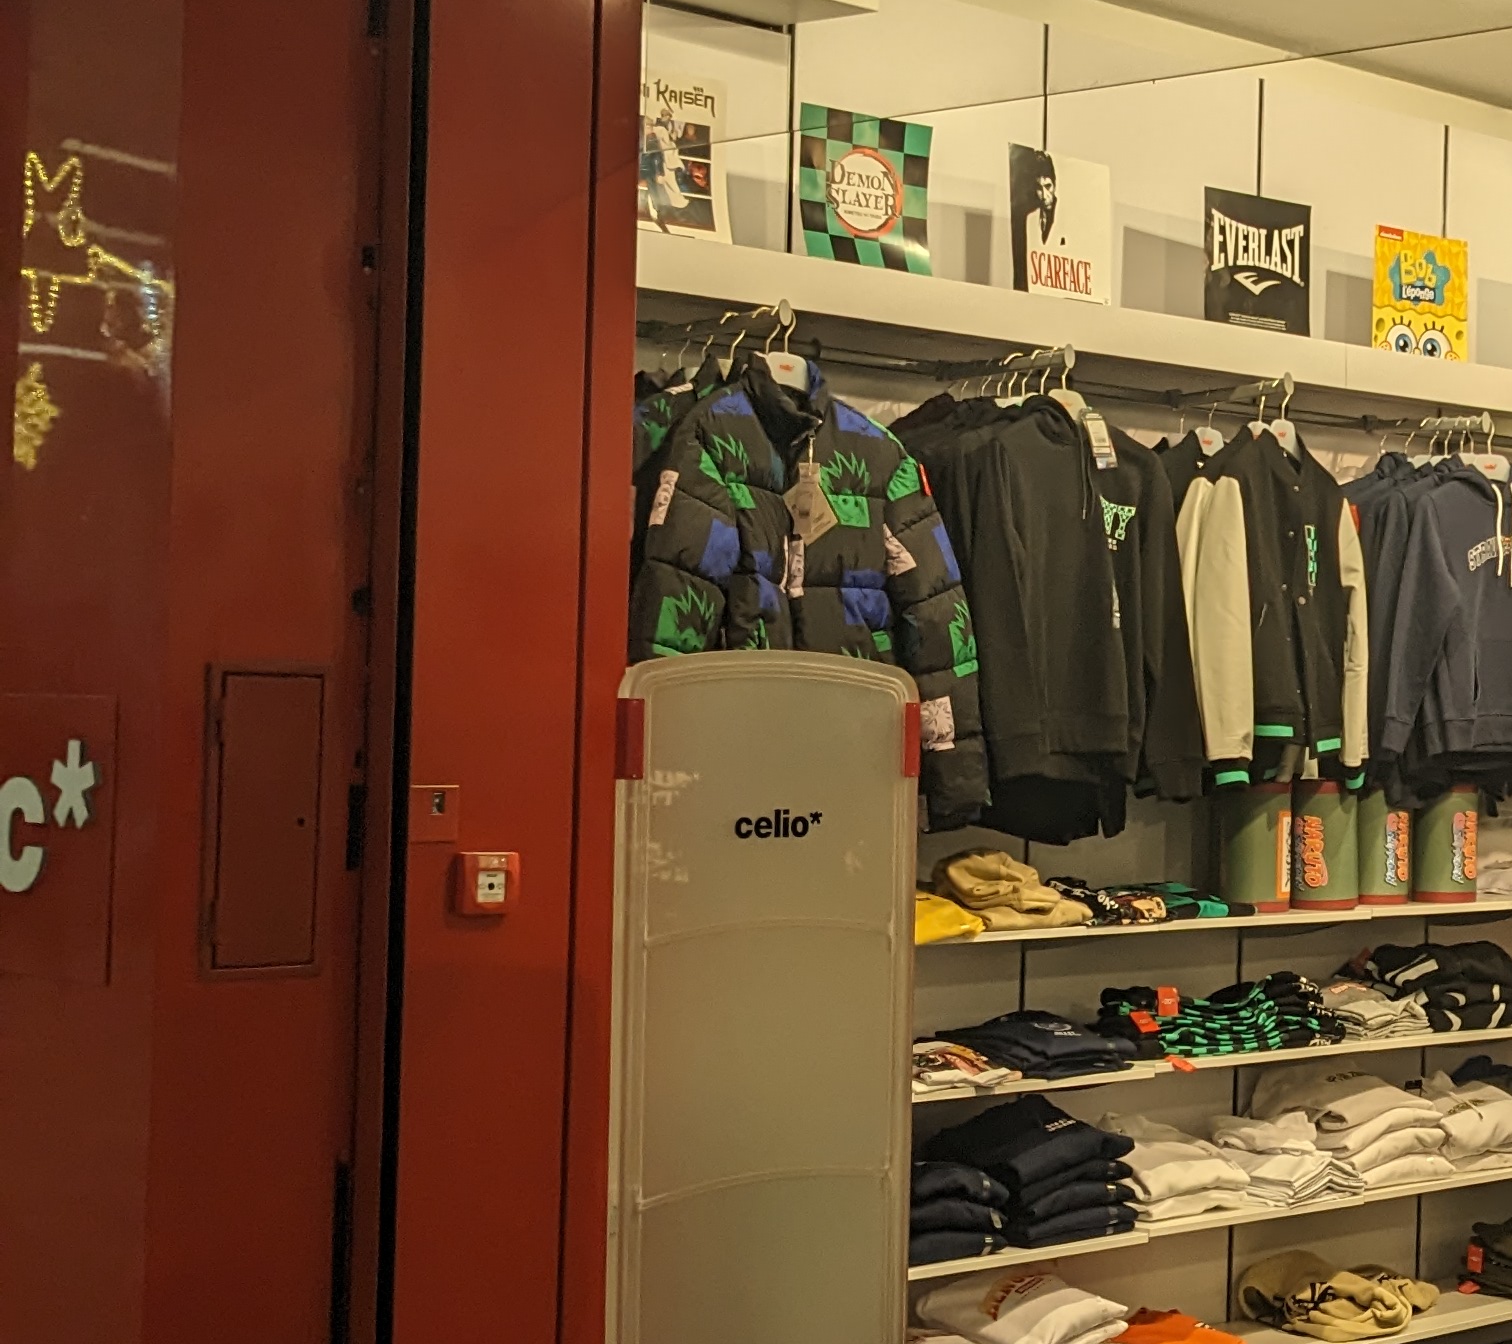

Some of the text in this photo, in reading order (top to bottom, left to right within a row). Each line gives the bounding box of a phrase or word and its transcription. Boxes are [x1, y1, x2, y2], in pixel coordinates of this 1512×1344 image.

[828, 159, 896, 192] DEMON
[826, 187, 901, 218] SLAYER
[1210, 208, 1304, 286] EVERLAST
[1401, 249, 1437, 287] Bob
[1030, 250, 1092, 295] SCARFACE
[1303, 815, 1325, 887] NARUTO
[1464, 810, 1478, 879] NARUTO
